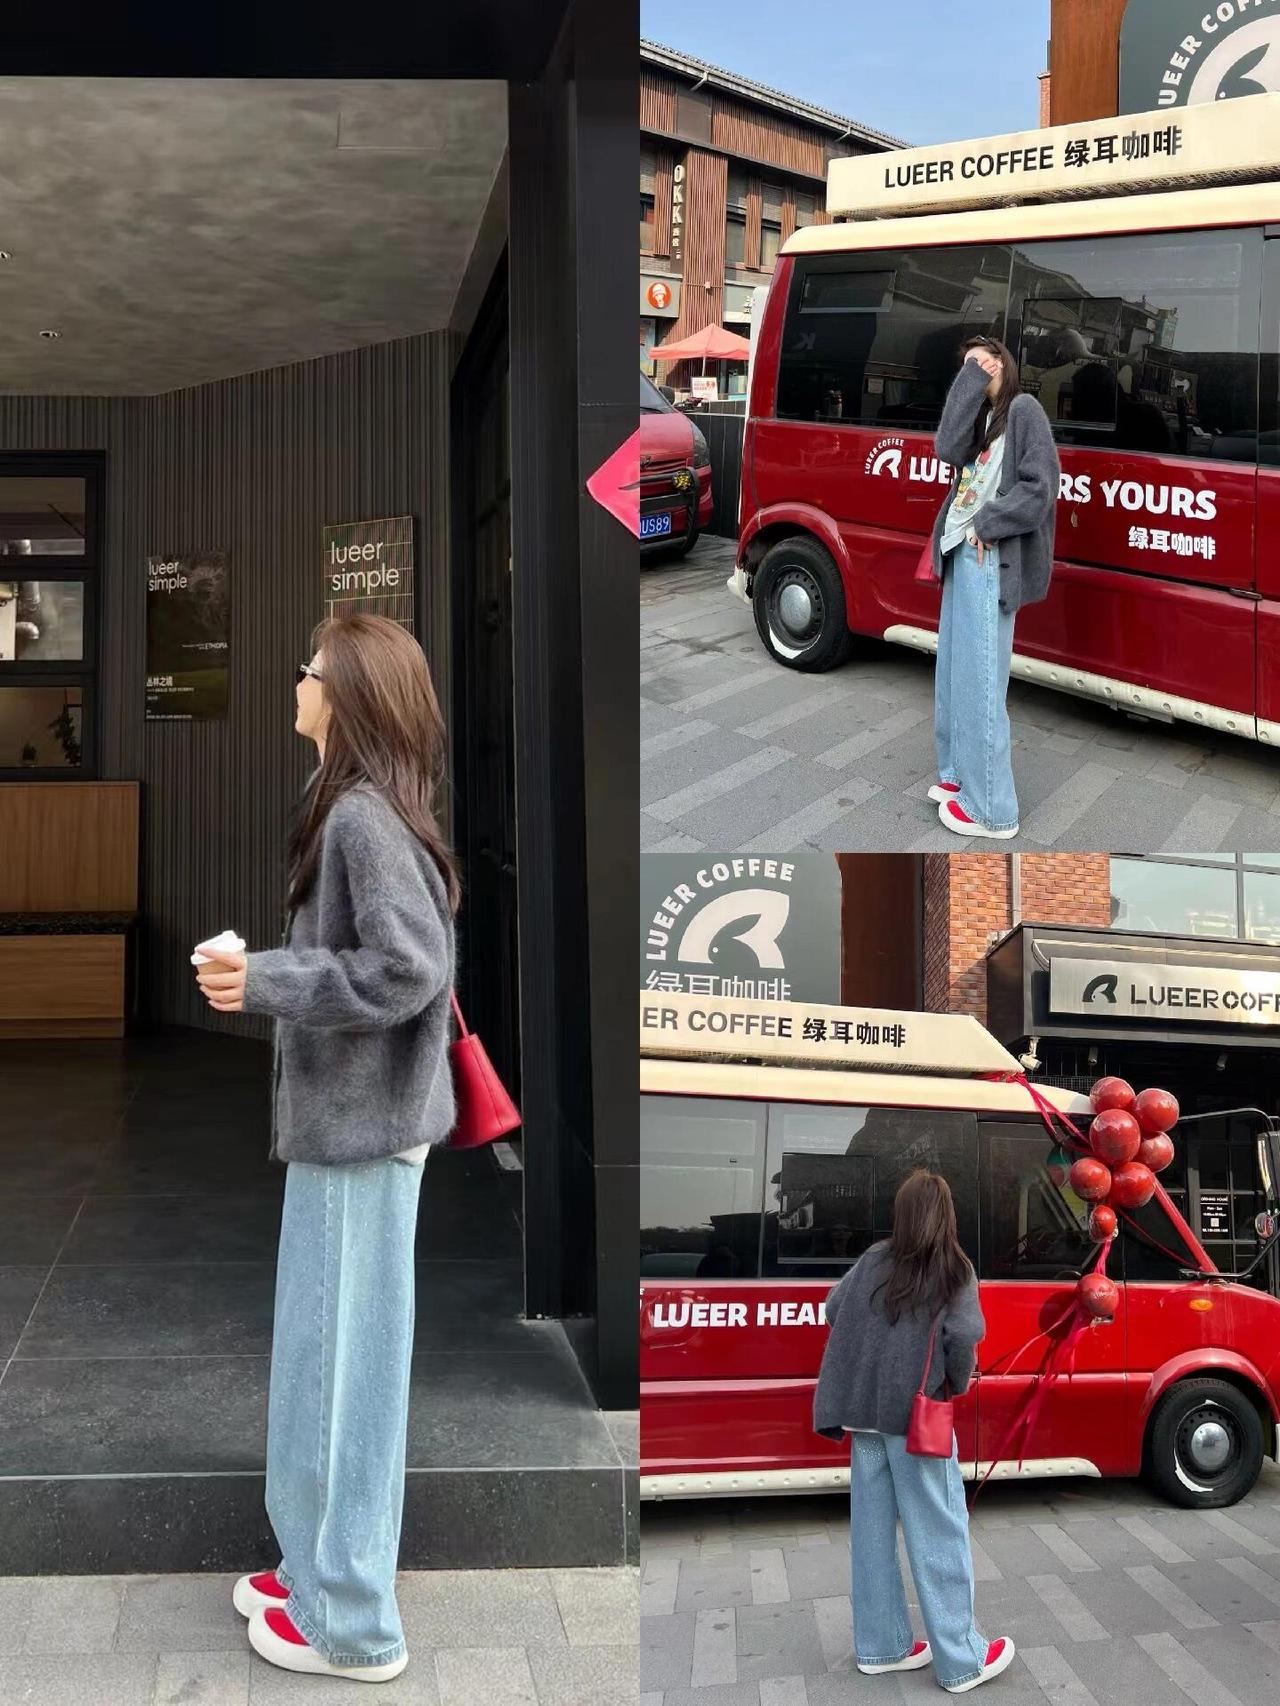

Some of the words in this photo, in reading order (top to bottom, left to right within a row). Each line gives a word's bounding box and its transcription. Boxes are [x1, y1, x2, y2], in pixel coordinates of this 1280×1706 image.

[885, 159, 954, 188] LUEER
[961, 145, 1054, 179] COFFEE
[1064, 125, 1183, 168] 绿耳咖啡
[878, 438, 905, 449] COFFEE
[909, 456, 957, 485] LUE
[1100, 480, 1217, 520] YOURS
[640, 516, 670, 535] US89
[331, 541, 384, 565] lueer
[1128, 526, 1216, 560] 绿耳咖啡
[148, 561, 180, 576] lueer
[332, 562, 399, 595] simple
[148, 573, 187, 595] simple
[646, 883, 697, 960] LUEER
[696, 858, 795, 889] COFFEE
[642, 1007, 679, 1031] ER
[688, 1011, 792, 1038] COFFEE
[802, 1016, 906, 1047] 绿耳咖啡
[653, 1303, 749, 1328] LUEER
